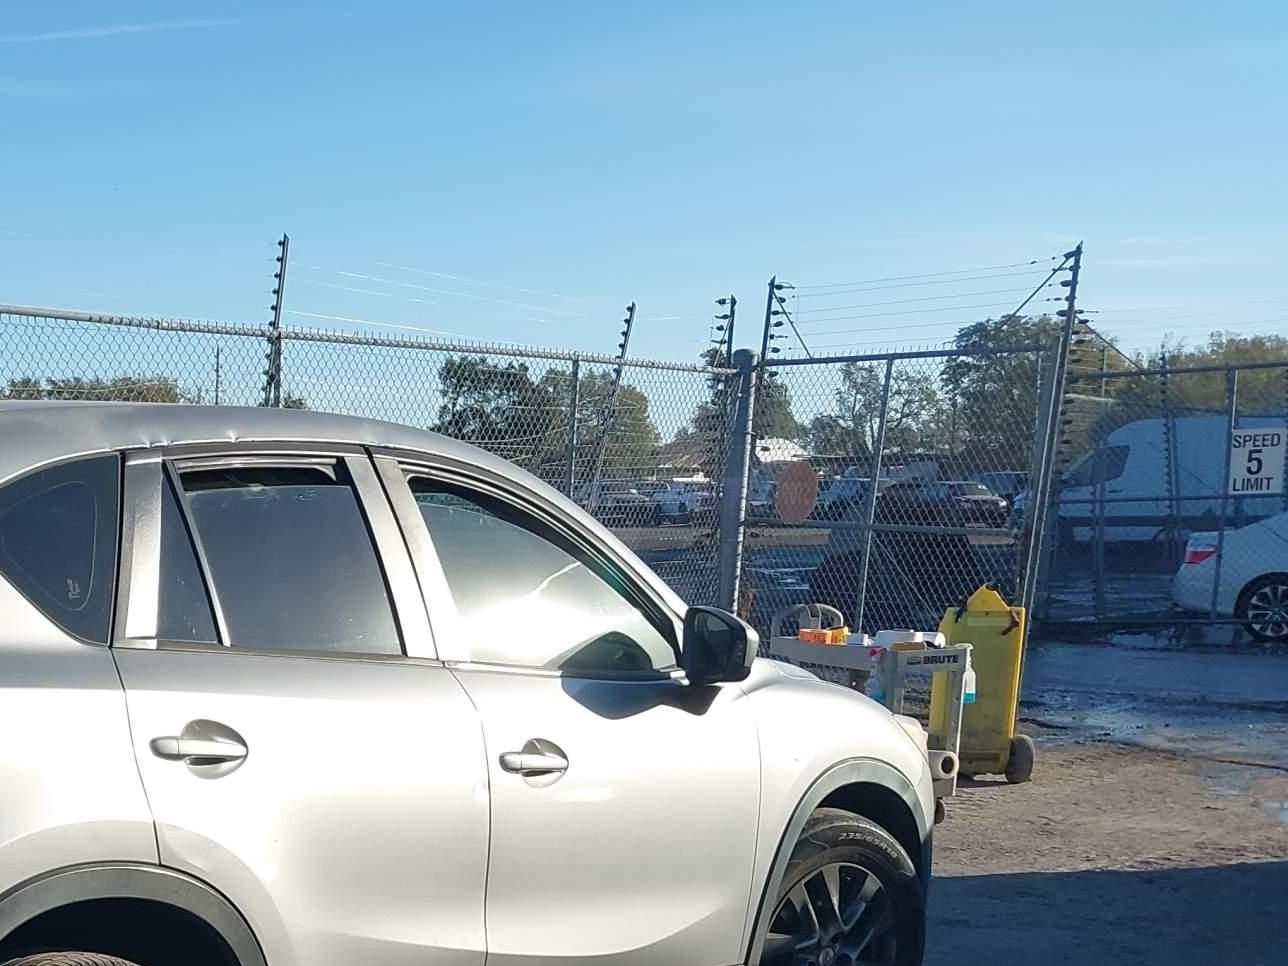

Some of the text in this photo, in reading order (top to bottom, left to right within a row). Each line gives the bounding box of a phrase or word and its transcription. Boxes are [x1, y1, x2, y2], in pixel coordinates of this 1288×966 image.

[1232, 432, 1281, 449] SPEED
[1246, 448, 1263, 476] 5
[1232, 476, 1274, 492] LIMIT
[923, 654, 959, 665] BRUTE
